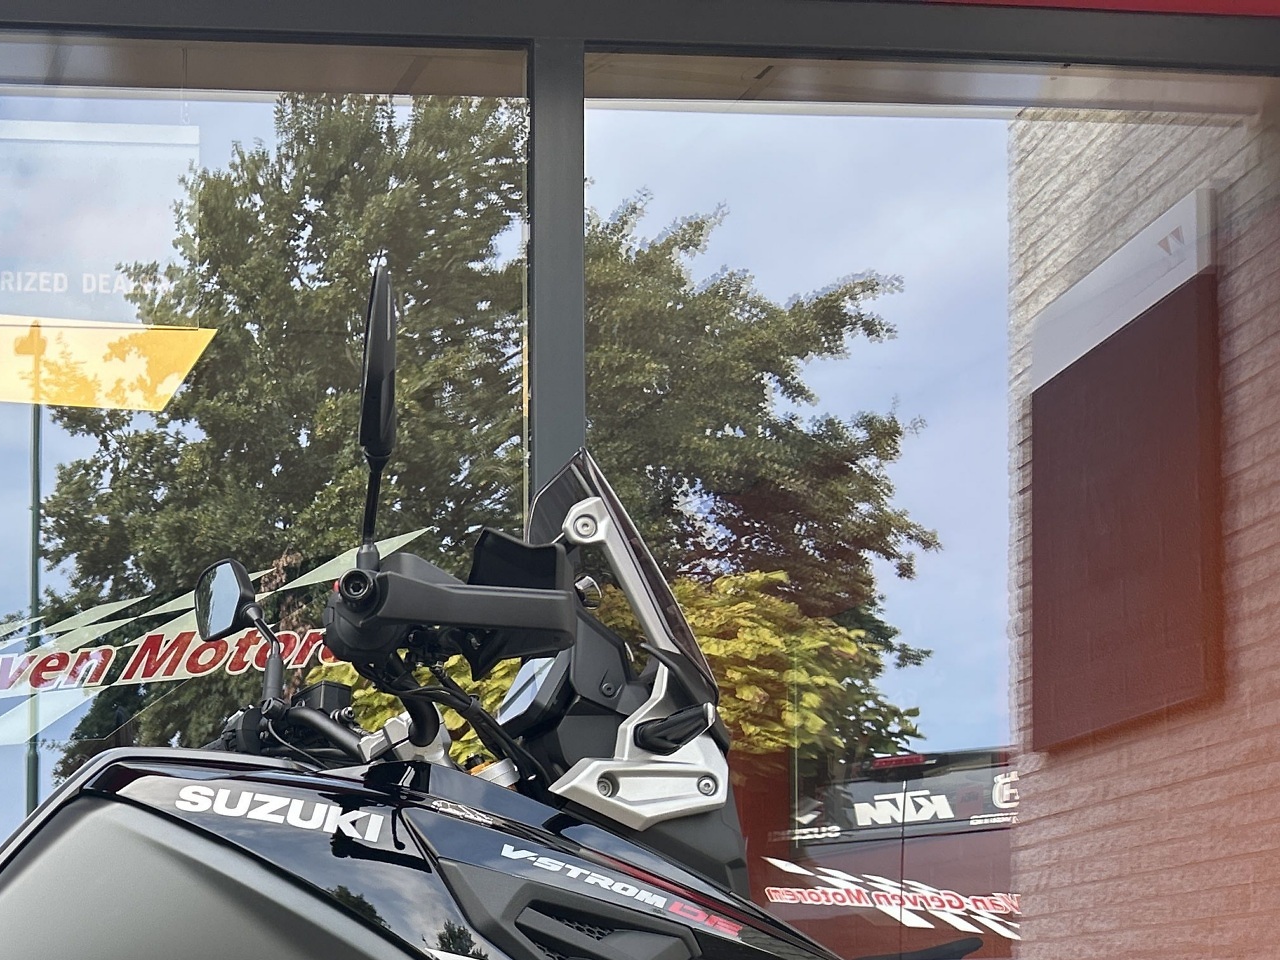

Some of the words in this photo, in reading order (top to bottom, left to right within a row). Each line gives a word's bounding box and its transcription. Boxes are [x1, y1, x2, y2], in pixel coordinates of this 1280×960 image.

[175, 785, 384, 843] SUZUKI
[501, 843, 668, 909] V-STROM
[669, 901, 743, 937] DE
